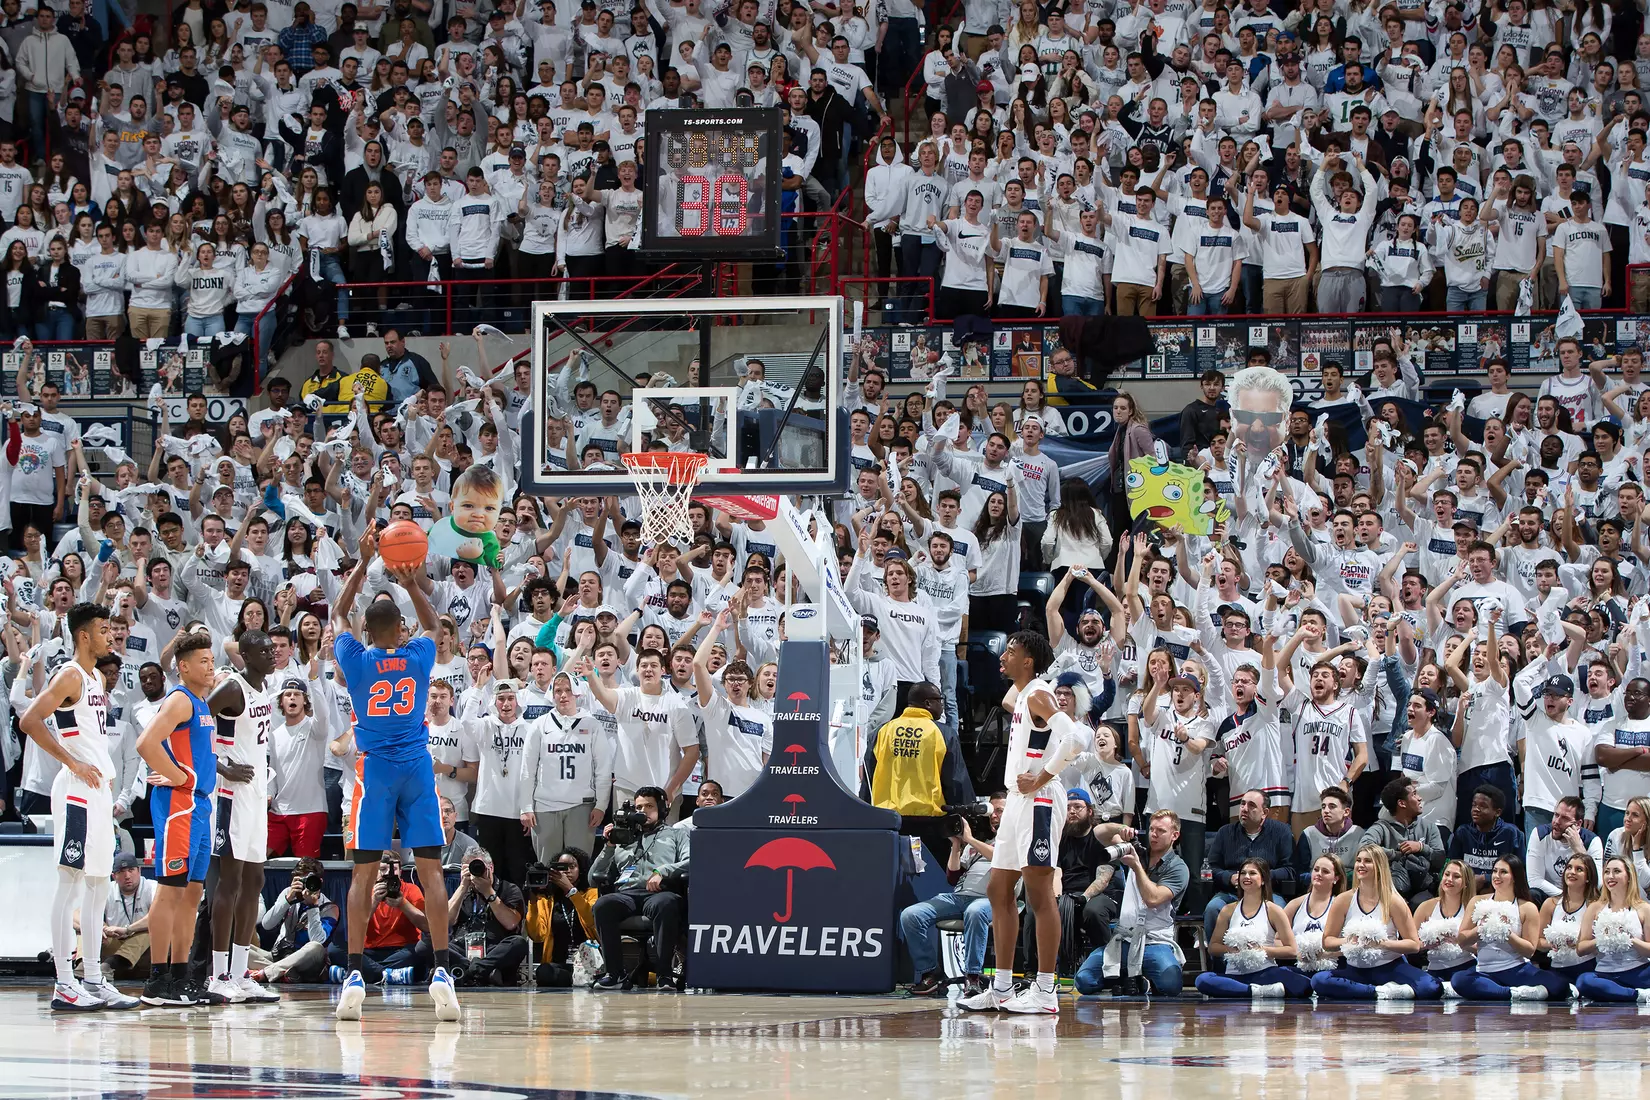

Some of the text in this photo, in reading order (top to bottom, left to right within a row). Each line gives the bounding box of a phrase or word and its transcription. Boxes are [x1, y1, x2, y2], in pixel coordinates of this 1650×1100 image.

[1538, 86, 1564, 96] UCONN
[684, 118, 743, 126] TS-SPORTS.COM
[174, 140, 199, 149] UCONN
[914, 181, 943, 198] UCONN
[1514, 222, 1524, 236] 15
[1569, 232, 1600, 242] UCONN
[214, 249, 237, 259] CONN
[192, 276, 225, 290] UCONN
[1464, 326, 1472, 336] 31
[1517, 324, 1525, 334] 14
[1624, 322, 1629, 332] 4
[1203, 329, 1210, 338] 31
[1254, 328, 1262, 338] 23
[898, 334, 905, 344] 32
[52, 352, 63, 363] 52
[97, 351, 109, 362] 42
[356, 372, 378, 381] CSC
[151, 404, 181, 418] SEC
[1340, 563, 1370, 575] UCONN
[831, 587, 853, 619] SPORTS
[861, 615, 877, 623] CONN
[889, 609, 925, 625] UCONN
[376, 658, 407, 674] LEWIS
[367, 677, 417, 717] 23
[632, 707, 669, 724] UCONN
[772, 712, 821, 722] TRAVELERS
[95, 709, 107, 735] 12
[895, 726, 923, 738] CSC
[1302, 721, 1344, 738] CONNECTICUT
[894, 738, 921, 748] EVENT
[1311, 736, 1330, 756] 34
[548, 744, 586, 754] UCONN
[893, 748, 920, 759] STAFF
[1173, 746, 1182, 766] 3
[559, 755, 576, 780] 15
[769, 766, 820, 776] TRAVELERS
[768, 815, 819, 825] TRAVELERS
[688, 923, 884, 959] TRAVELERS
